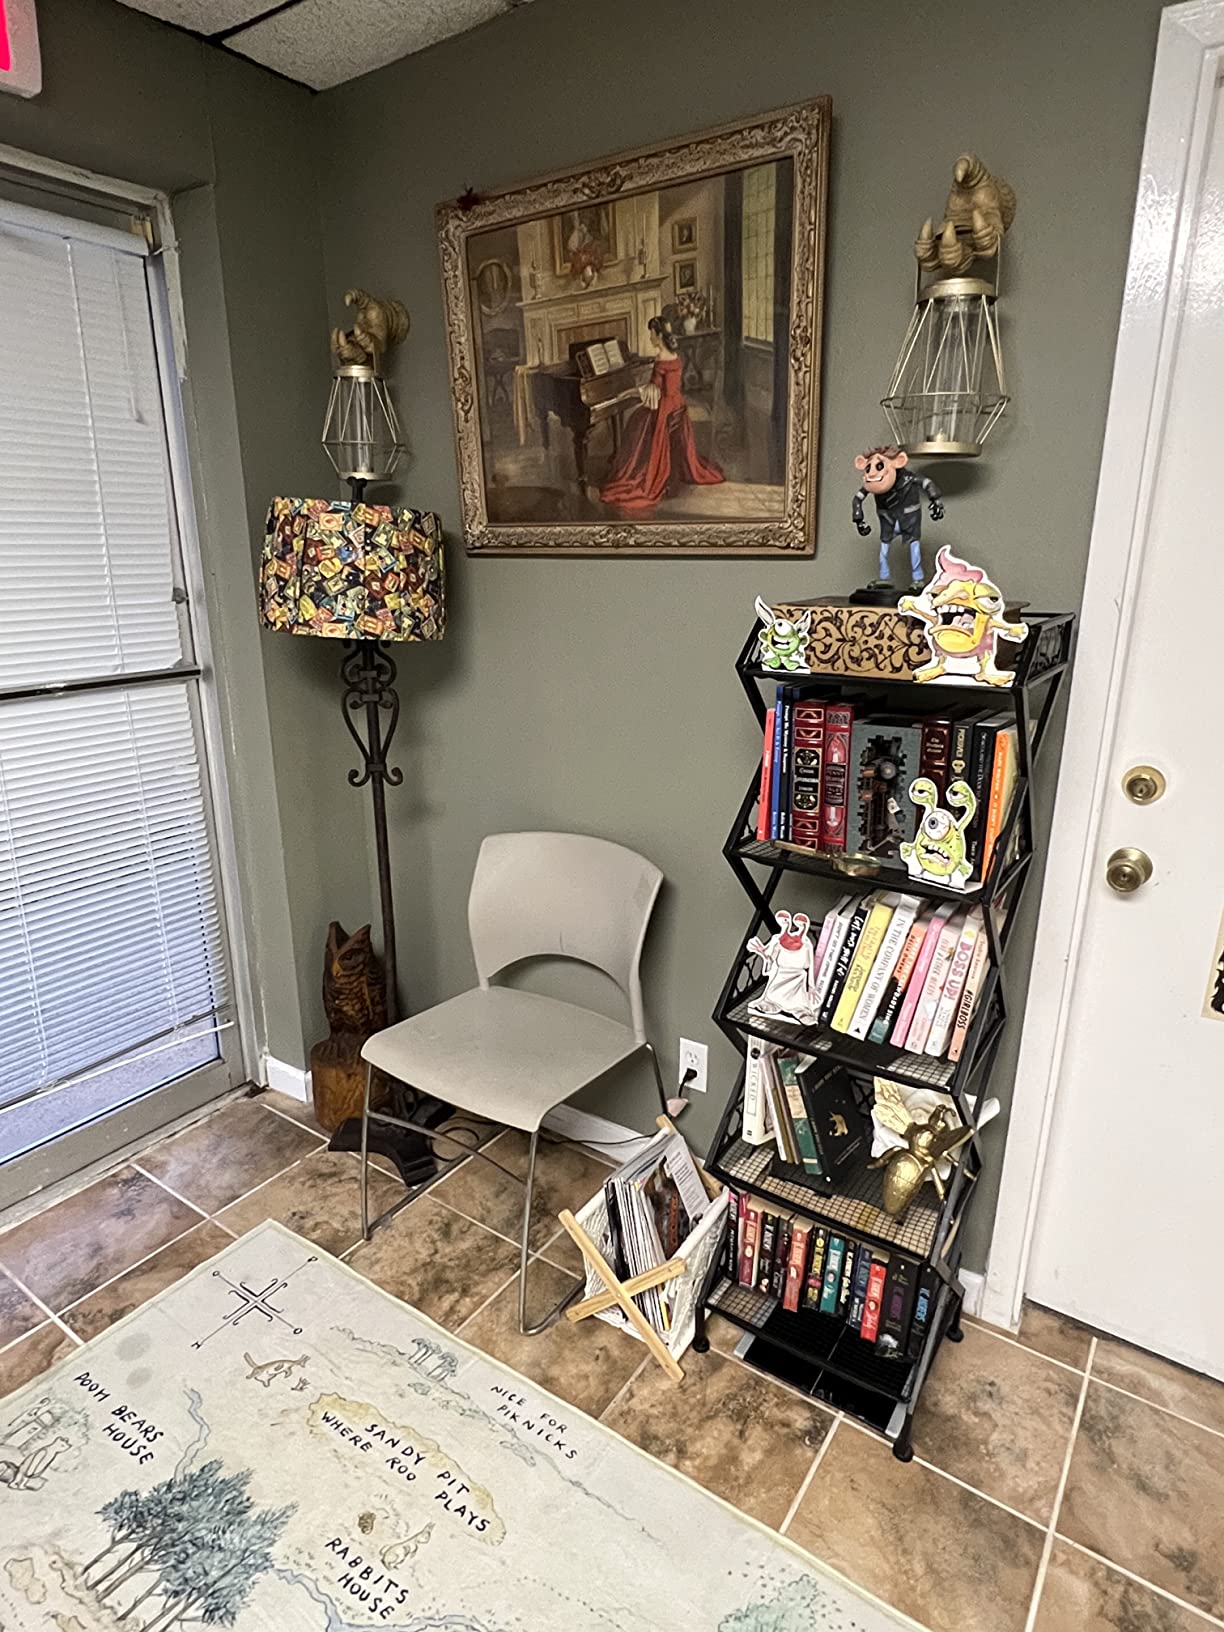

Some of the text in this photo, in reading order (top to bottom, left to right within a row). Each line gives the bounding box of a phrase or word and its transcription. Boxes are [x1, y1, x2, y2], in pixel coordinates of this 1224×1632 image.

[858, 917, 906, 1021] IN THE COMPANY OF WOMEN
[950, 940, 972, 978] BOSS
[942, 978, 960, 1001] UP!
[955, 988, 974, 1030] #GIRLBOSS
[749, 1063, 757, 1101] WICKED
[73, 1372, 164, 1442] POOH BEARS
[490, 1386, 568, 1434] NICE FOR
[102, 1423, 154, 1465] HOUSE
[497, 1404, 577, 1459] PIKNICKS
[321, 1411, 491, 1532] WHERE ROO PLAYS
[365, 1424, 470, 1495] SANDY PIT
[324, 1537, 409, 1604] RABBITS
[337, 1572, 395, 1620] HOUSE
